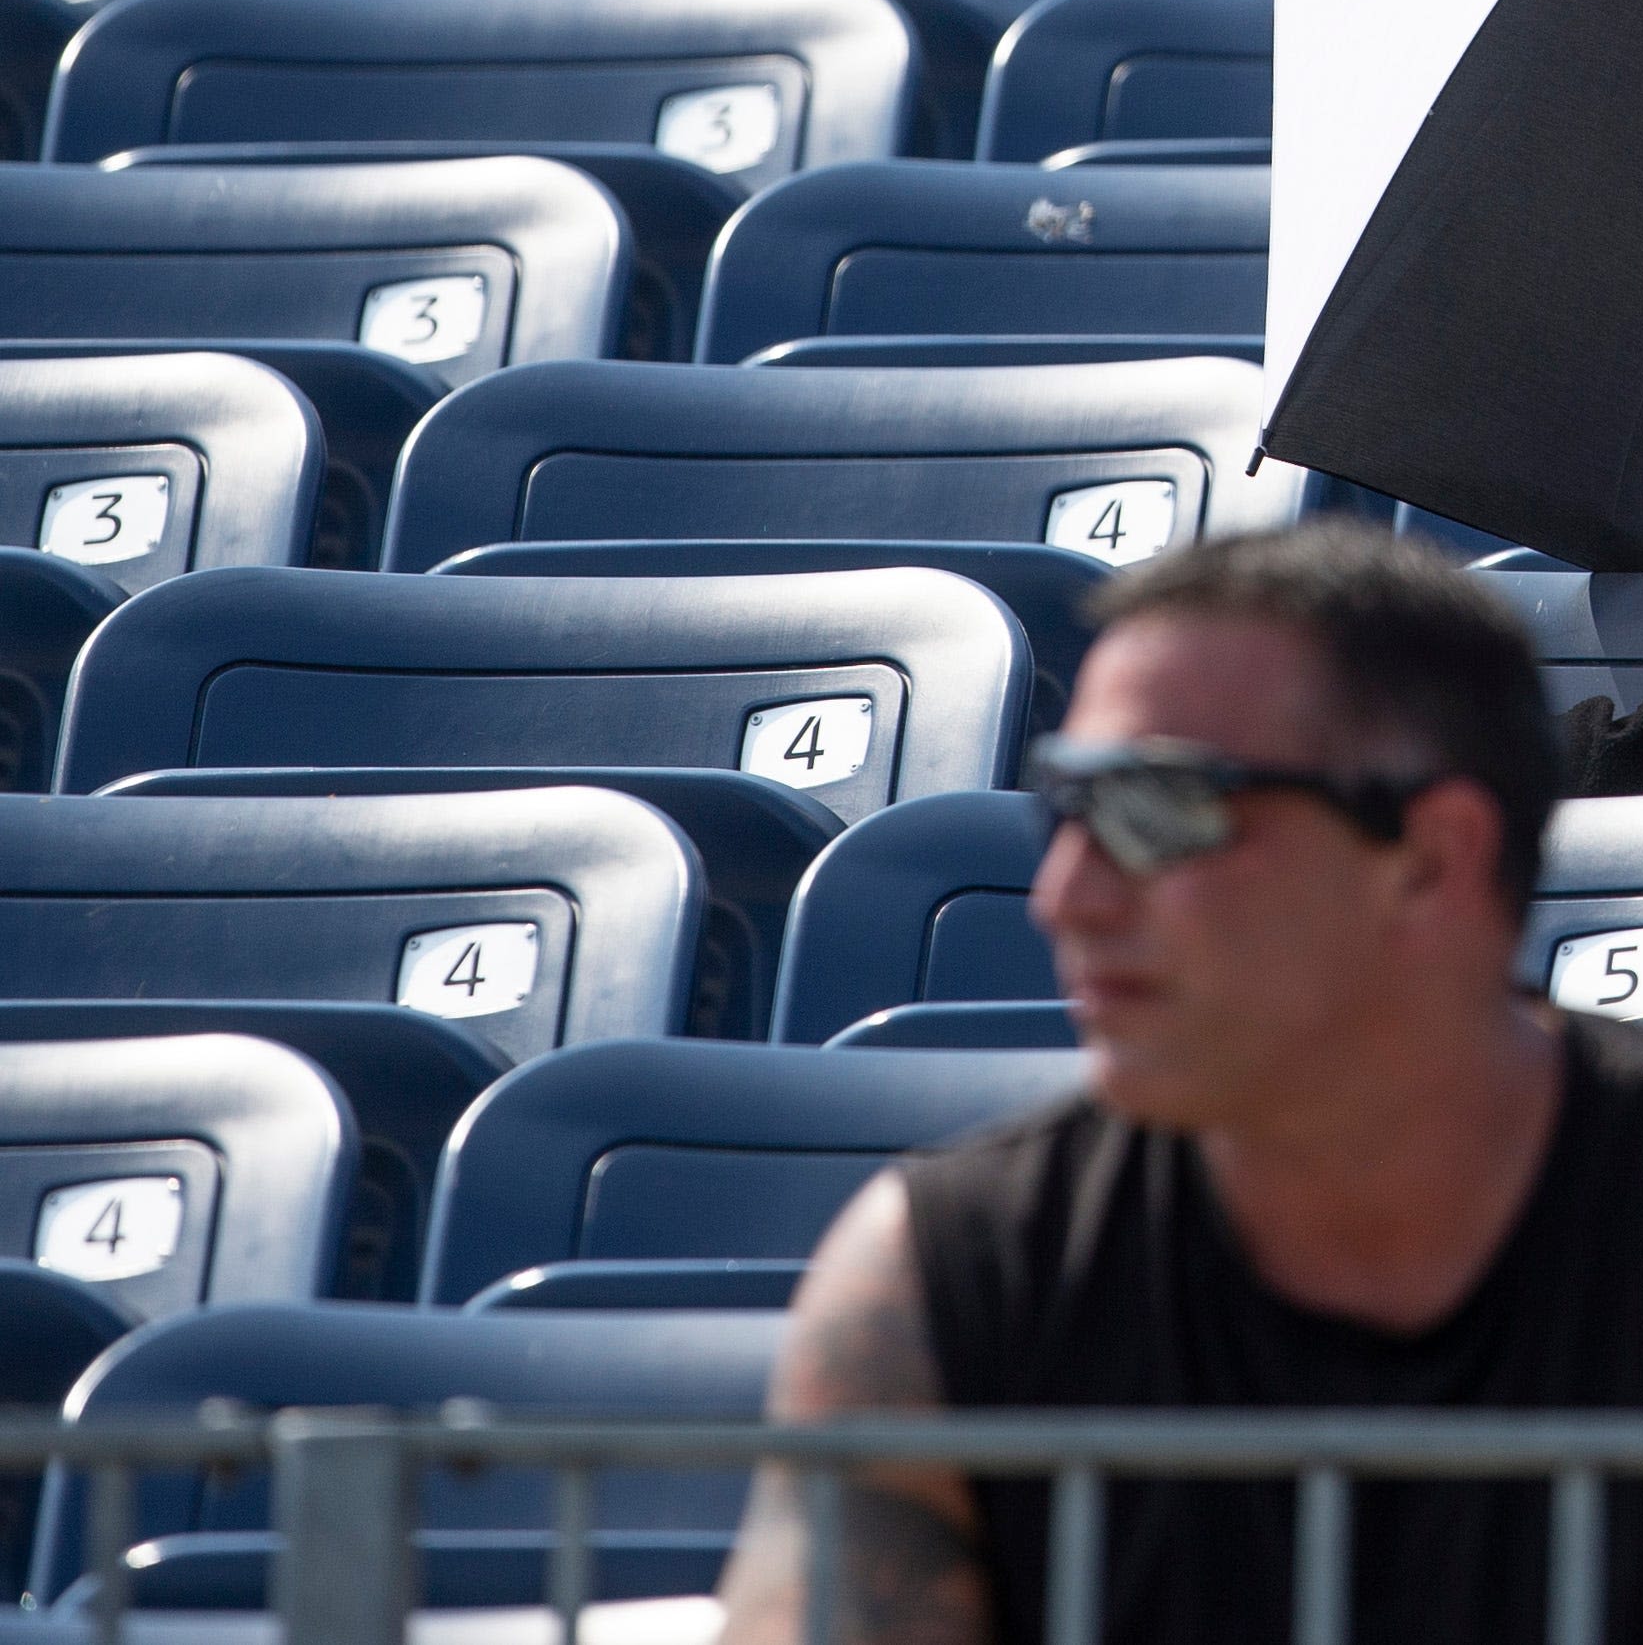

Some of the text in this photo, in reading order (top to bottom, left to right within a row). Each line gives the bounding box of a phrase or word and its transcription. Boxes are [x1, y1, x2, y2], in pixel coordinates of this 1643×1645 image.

[700, 103, 731, 151] 3
[402, 295, 437, 345] 3
[83, 493, 122, 546] 3
[1088, 499, 1126, 550] 4
[783, 716, 824, 769] 4
[443, 942, 485, 996] 4
[1597, 946, 1638, 1005] 5
[84, 1199, 125, 1254] 4
